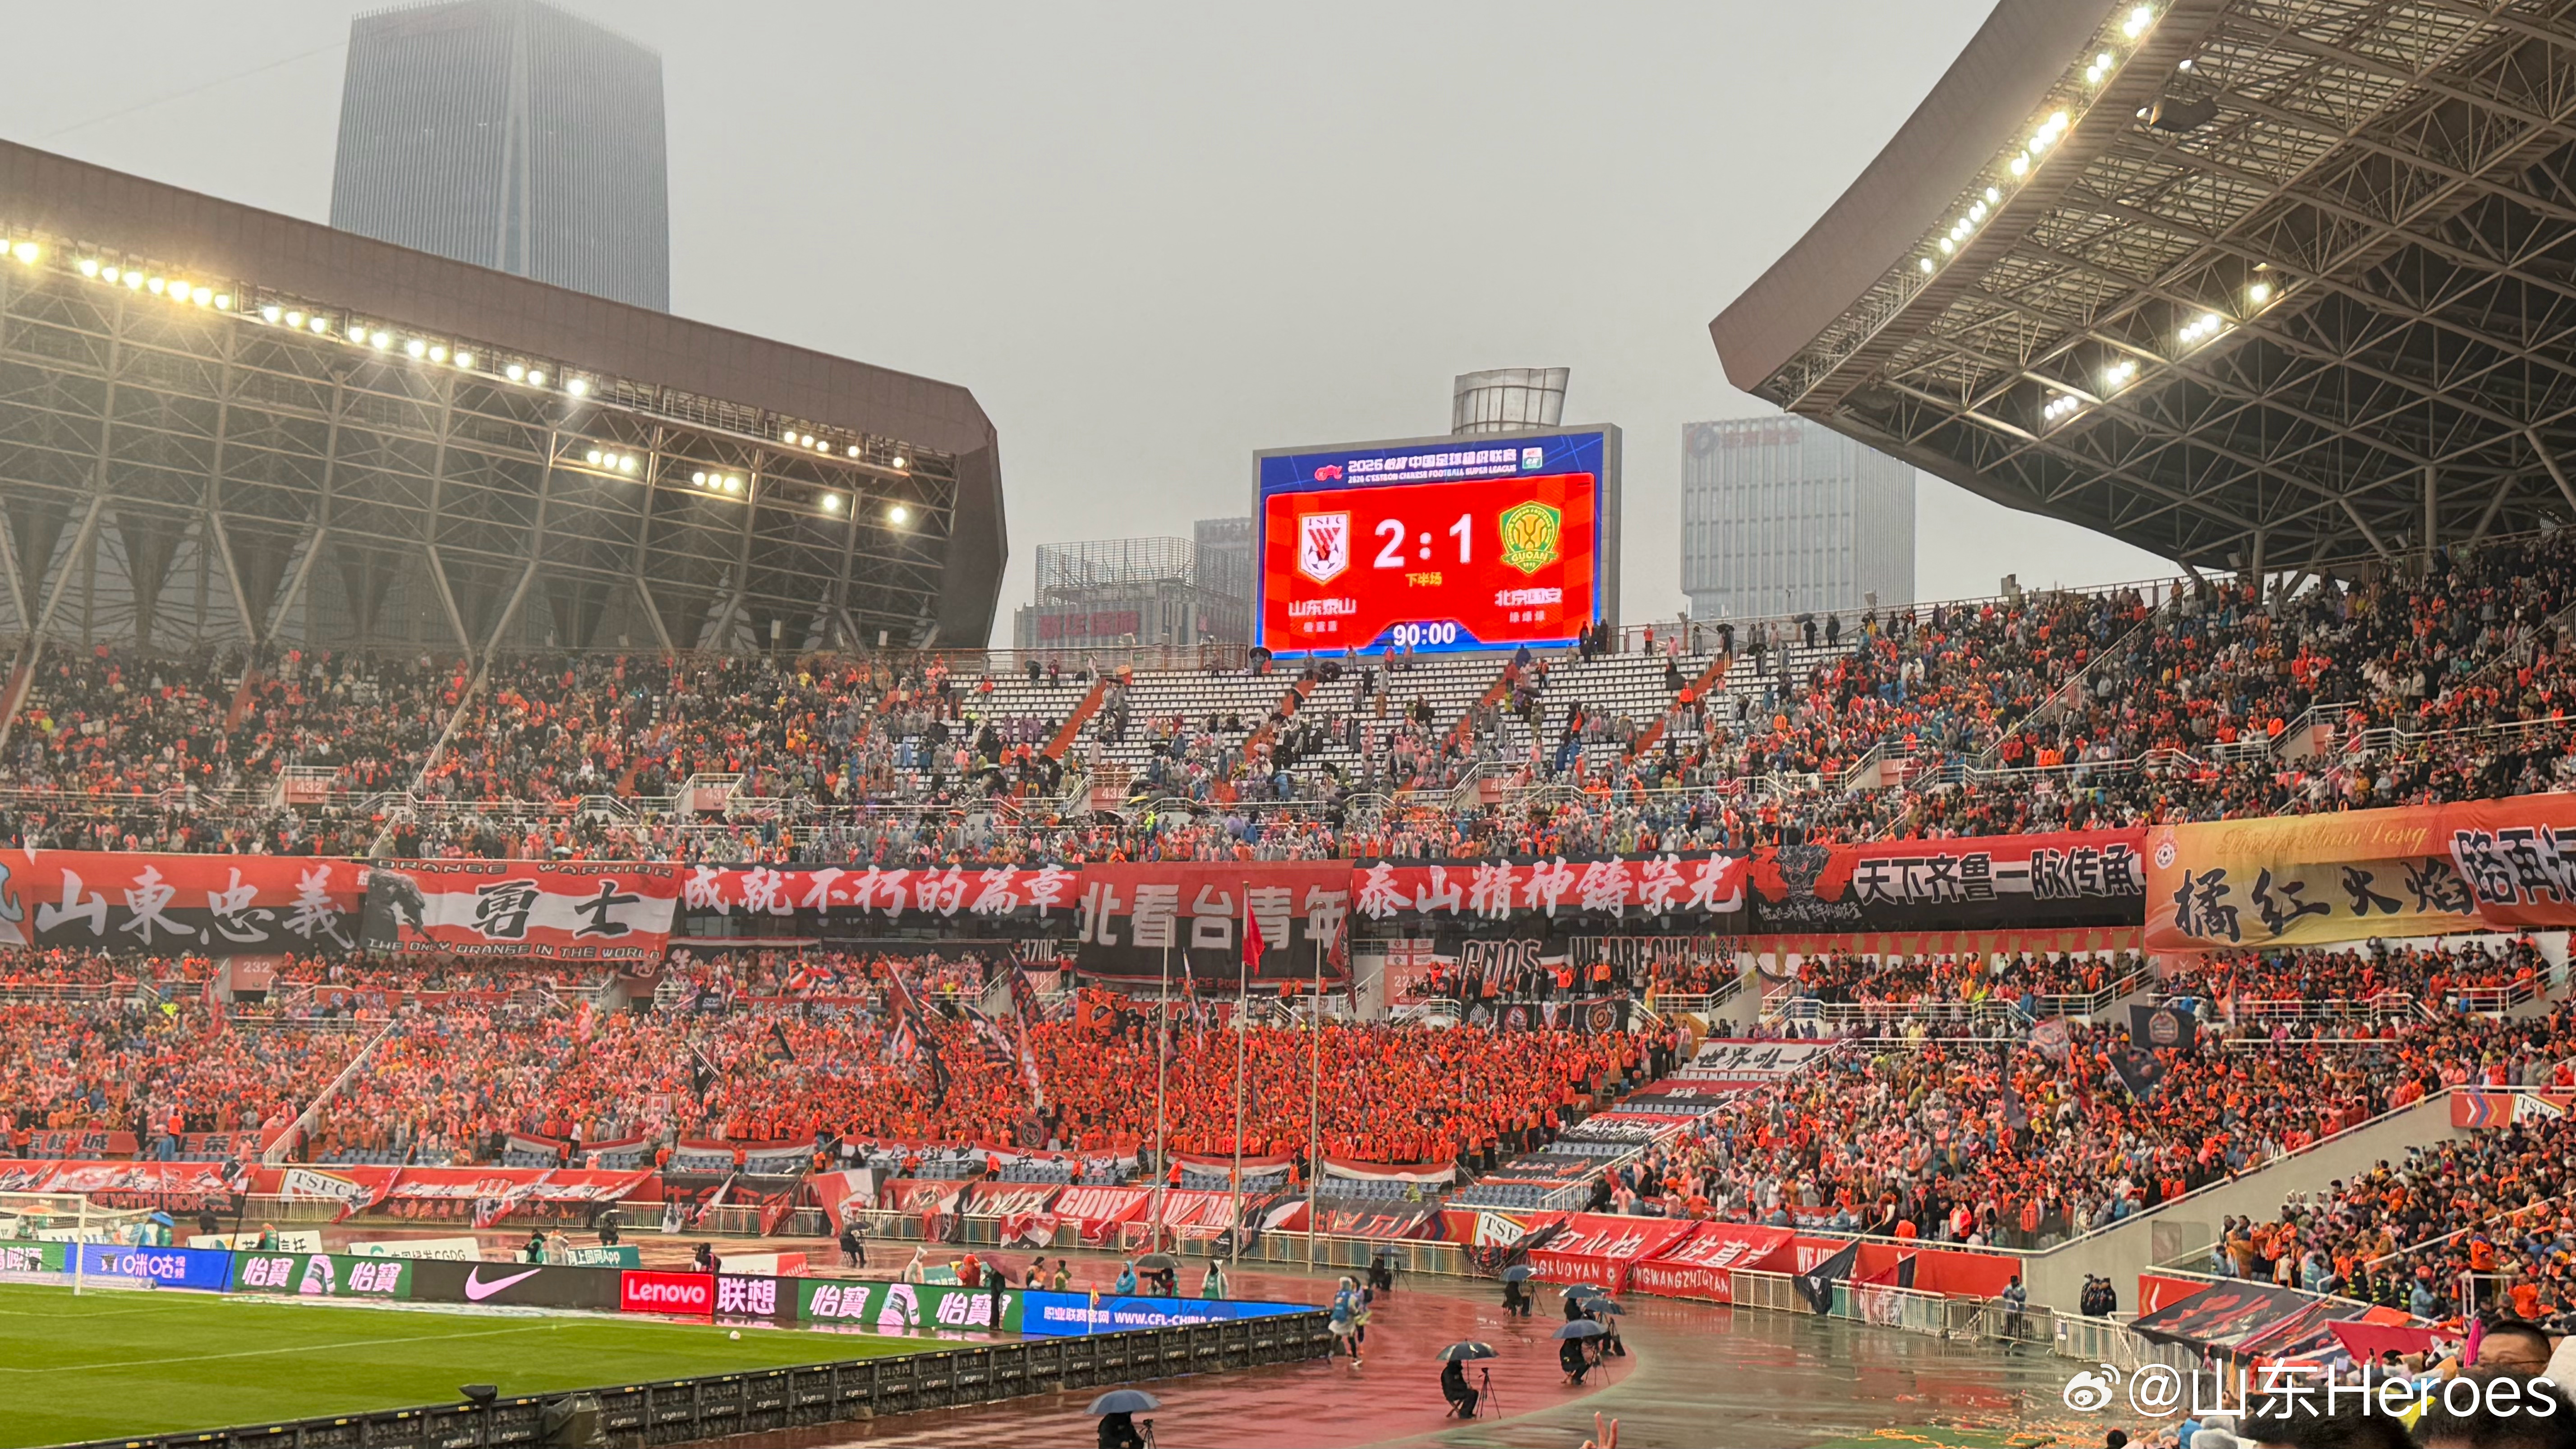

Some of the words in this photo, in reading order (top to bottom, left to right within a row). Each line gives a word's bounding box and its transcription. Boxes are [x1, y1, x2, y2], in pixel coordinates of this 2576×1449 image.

[1511, 552, 1548, 563] GUOAN
[1405, 571, 1442, 587] 下半场
[1288, 597, 1357, 616] 山东泰山
[1495, 587, 1562, 607] 北京国安
[1393, 622, 1456, 646] 90:00
[377, 859, 508, 875] ORANGE
[538, 862, 673, 878] WARRIOR
[1855, 842, 2143, 907] 天下齐鲁一脉传承
[685, 863, 1076, 918] 成就不朽的篇章
[2172, 856, 2475, 943] 橘红火焰
[35, 865, 355, 950] 山東忠義
[471, 879, 641, 940] 勇士
[1079, 881, 1348, 950] 北看台青年
[368, 938, 403, 951] THE
[455, 943, 531, 957] ORANGE
[535, 944, 553, 957] IN
[560, 946, 597, 958] THE
[601, 948, 662, 961] WORLD
[244, 961, 270, 974] 232
[293, 1171, 347, 1196] TSFC
[1484, 1214, 1520, 1241] TSF
[1797, 1246, 1814, 1272] WE
[629, 1278, 706, 1303] Lenovo
[717, 1278, 777, 1315] 联想
[1044, 1306, 1109, 1324] 职业联赛官网
